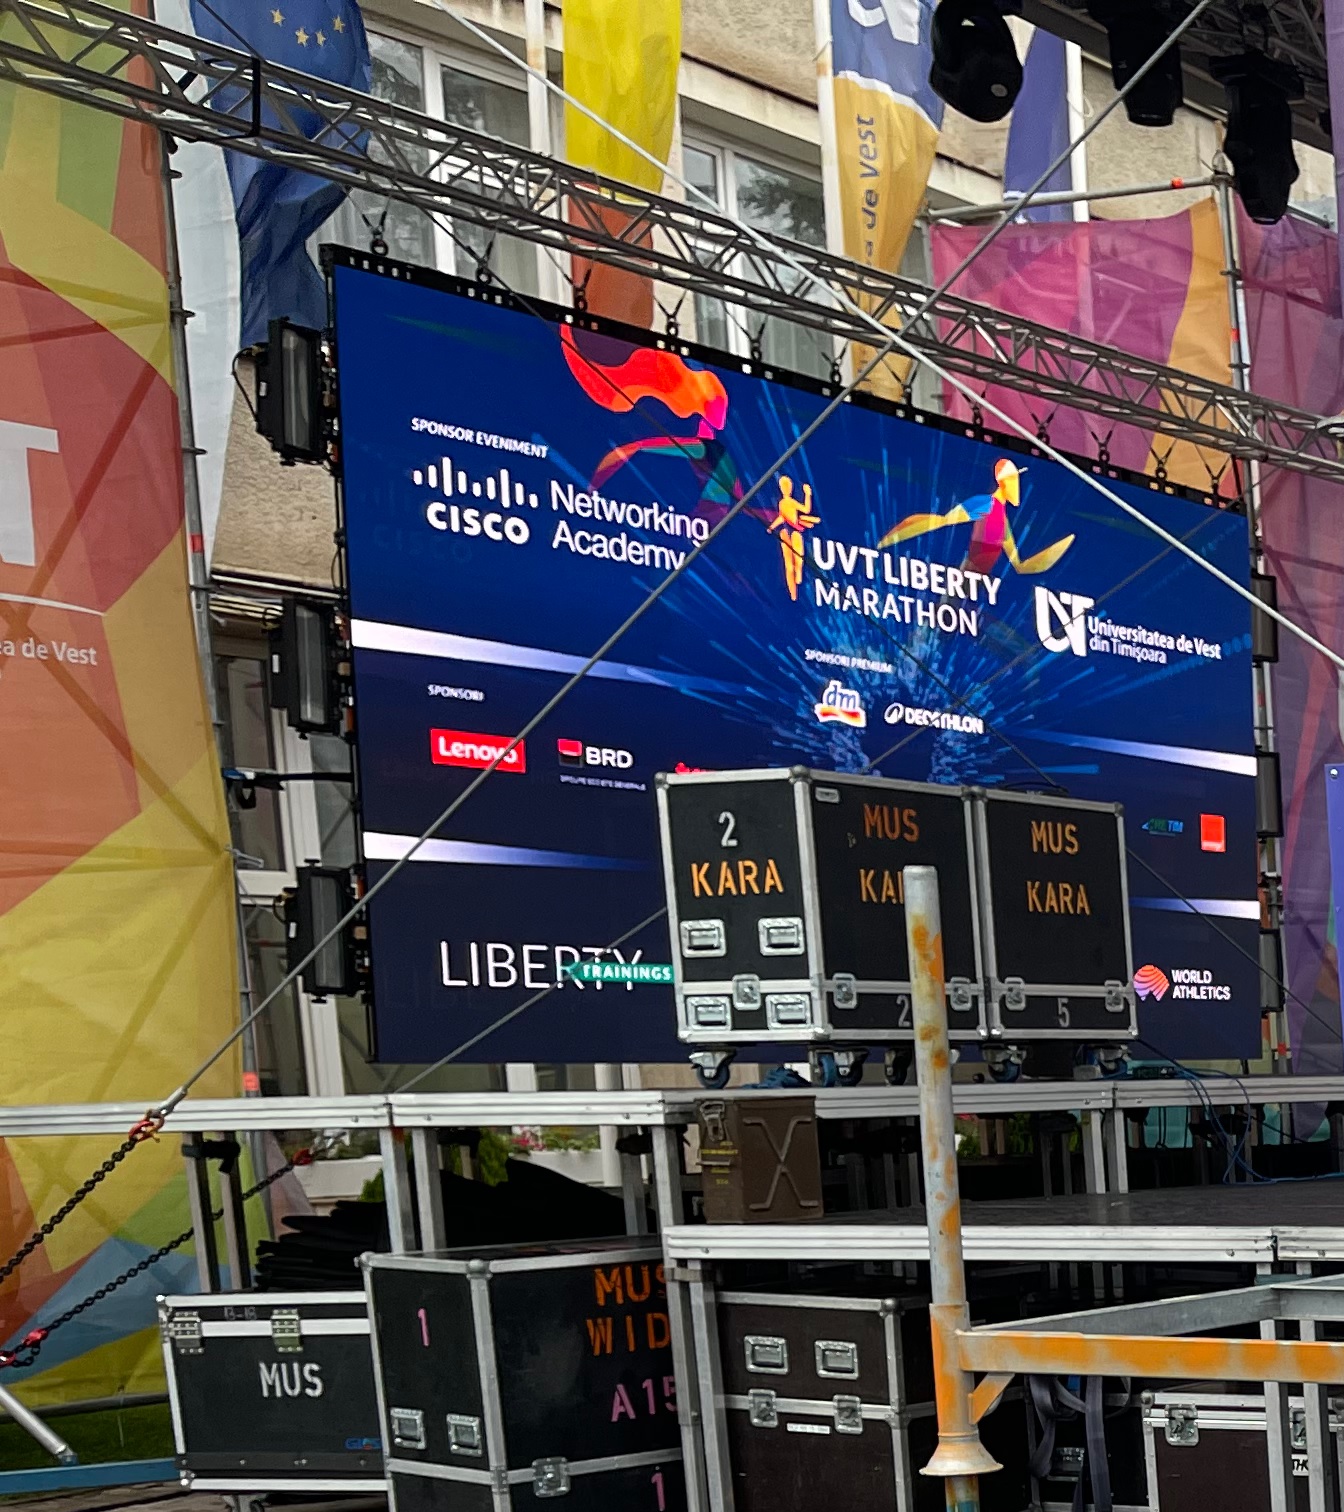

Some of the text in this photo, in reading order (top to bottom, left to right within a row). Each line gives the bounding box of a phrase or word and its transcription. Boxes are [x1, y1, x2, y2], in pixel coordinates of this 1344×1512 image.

[411, 418, 548, 458] SPONSOR EVENIMENT
[426, 502, 530, 545] CISCO
[551, 480, 710, 548] Networking
[813, 537, 1001, 605] UVT LIBERTY
[815, 580, 978, 637] MARATHON
[21, 637, 49, 655] de
[51, 640, 98, 666] Vest
[1087, 615, 1222, 660] Universitatea de Vest
[1090, 636, 1167, 664] din Timișoara
[904, 706, 985, 734] DECATHLON
[438, 736, 519, 764] Lenovo
[586, 746, 634, 768] BRD
[718, 811, 739, 848] 2
[863, 804, 920, 843] MUS
[1031, 820, 1080, 855] MUS
[691, 859, 785, 898] KARA
[860, 869, 904, 905] KA
[1027, 880, 1092, 917] KARA
[440, 941, 643, 991] LIBERTY
[582, 963, 671, 982] TRAININGS
[1172, 969, 1213, 985] WORLD
[1172, 983, 1231, 1001] ATHLETICS
[1057, 998, 1070, 1028] 5
[259, 1362, 323, 1398] MUS
